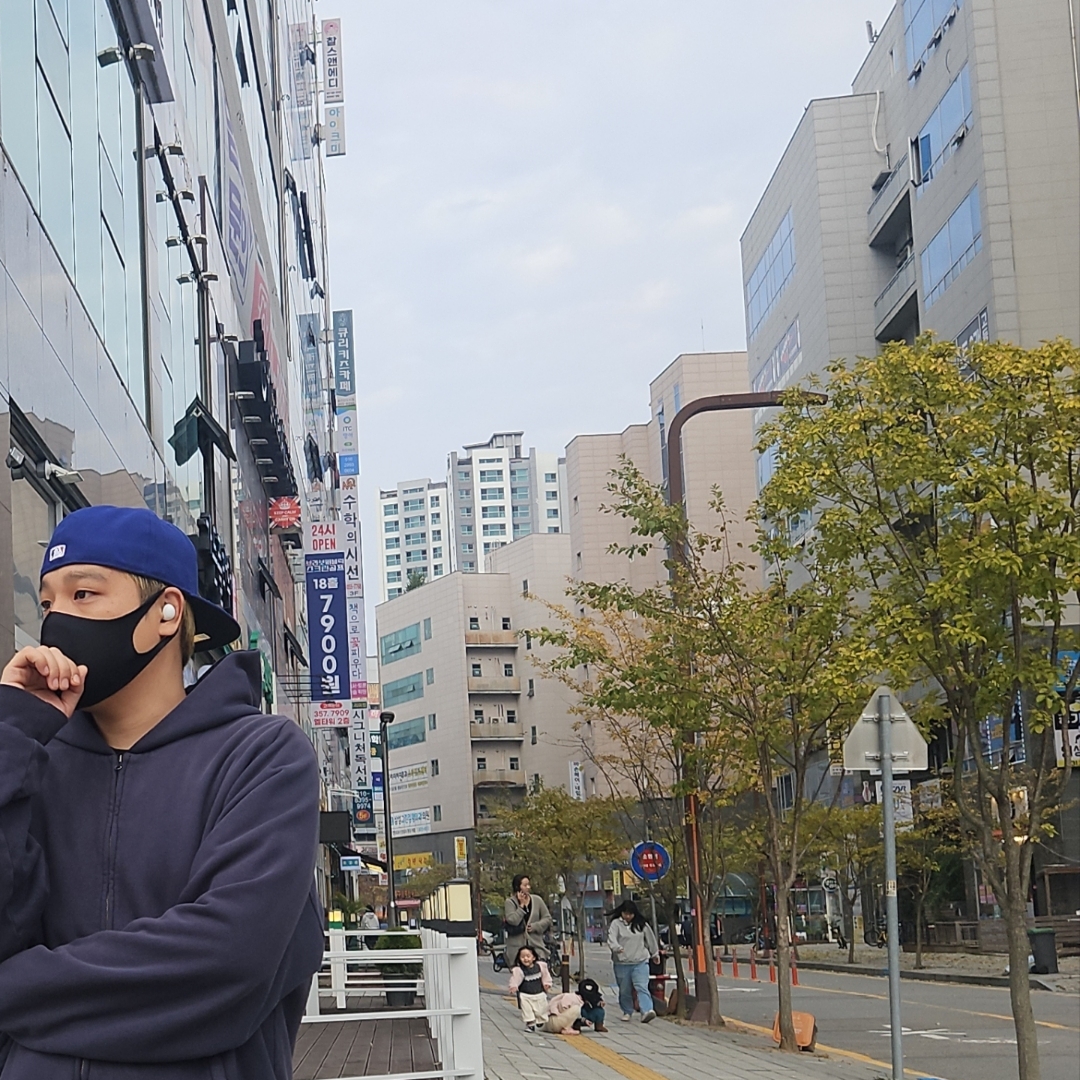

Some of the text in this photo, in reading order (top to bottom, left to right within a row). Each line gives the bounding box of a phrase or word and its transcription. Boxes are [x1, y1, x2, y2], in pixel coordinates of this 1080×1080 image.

[338, 327, 351, 392] 큐리키즈카페
[312, 523, 336, 537] 24시
[313, 538, 336, 551] OPEN
[353, 710, 368, 787] 시그니처독서실
